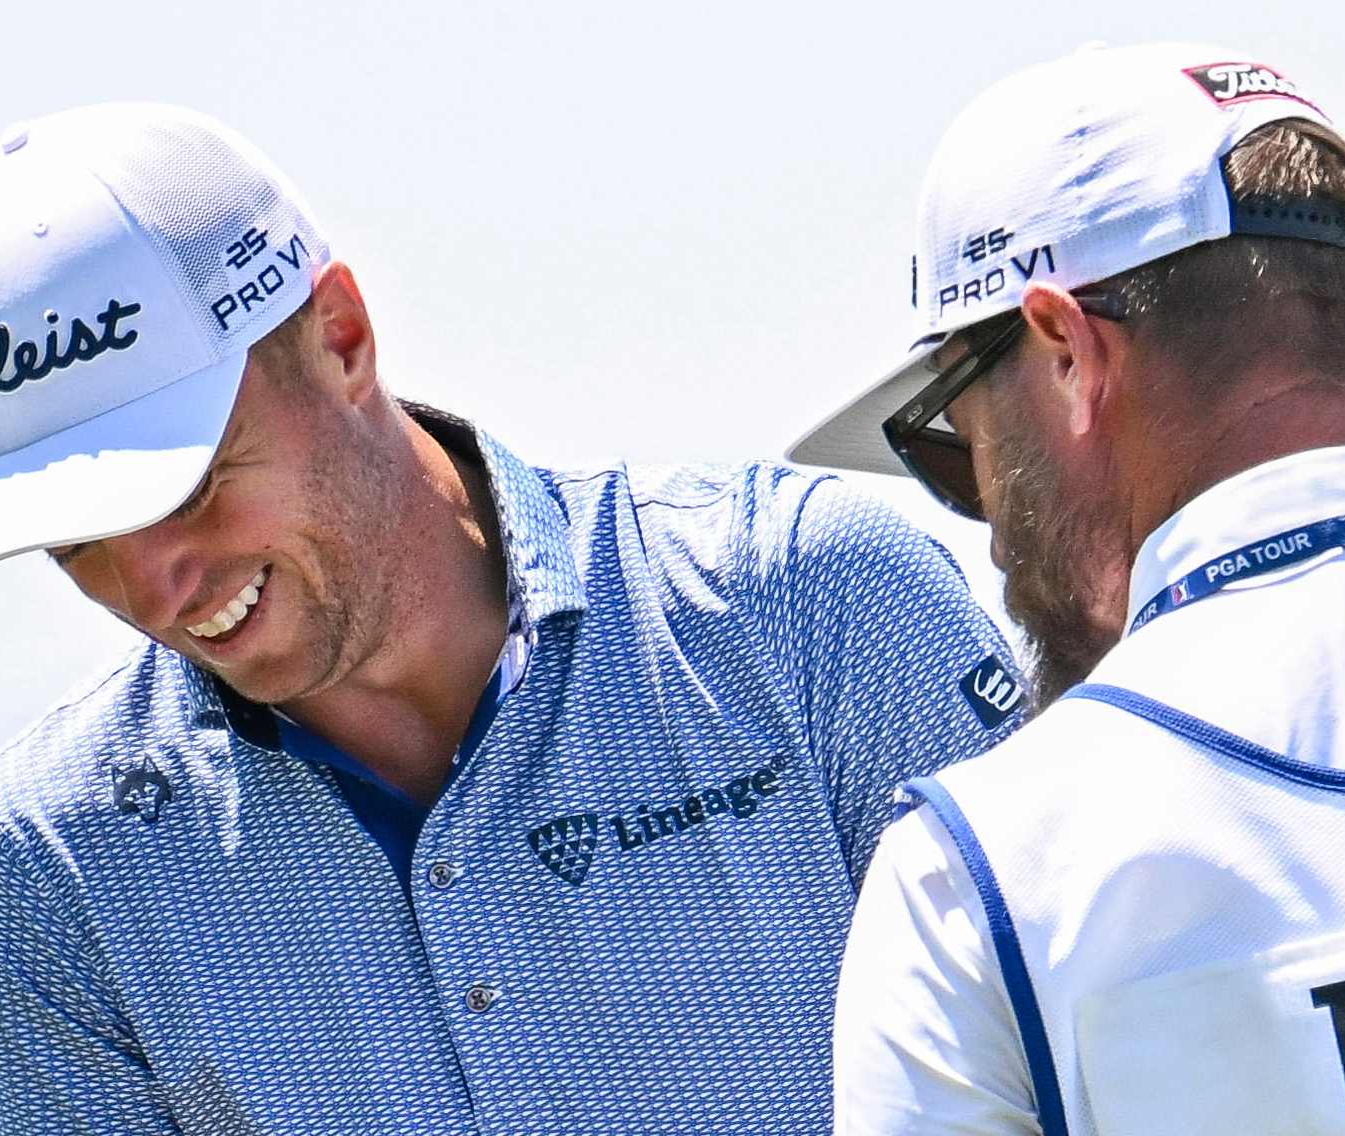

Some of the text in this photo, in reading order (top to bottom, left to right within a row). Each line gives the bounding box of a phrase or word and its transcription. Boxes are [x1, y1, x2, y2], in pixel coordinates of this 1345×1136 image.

[225, 227, 270, 270] 25
[963, 227, 1015, 263] 25
[211, 264, 284, 331] PRO
[940, 244, 1055, 317] PRO V1
[1206, 532, 1313, 583] PGA TOUR
